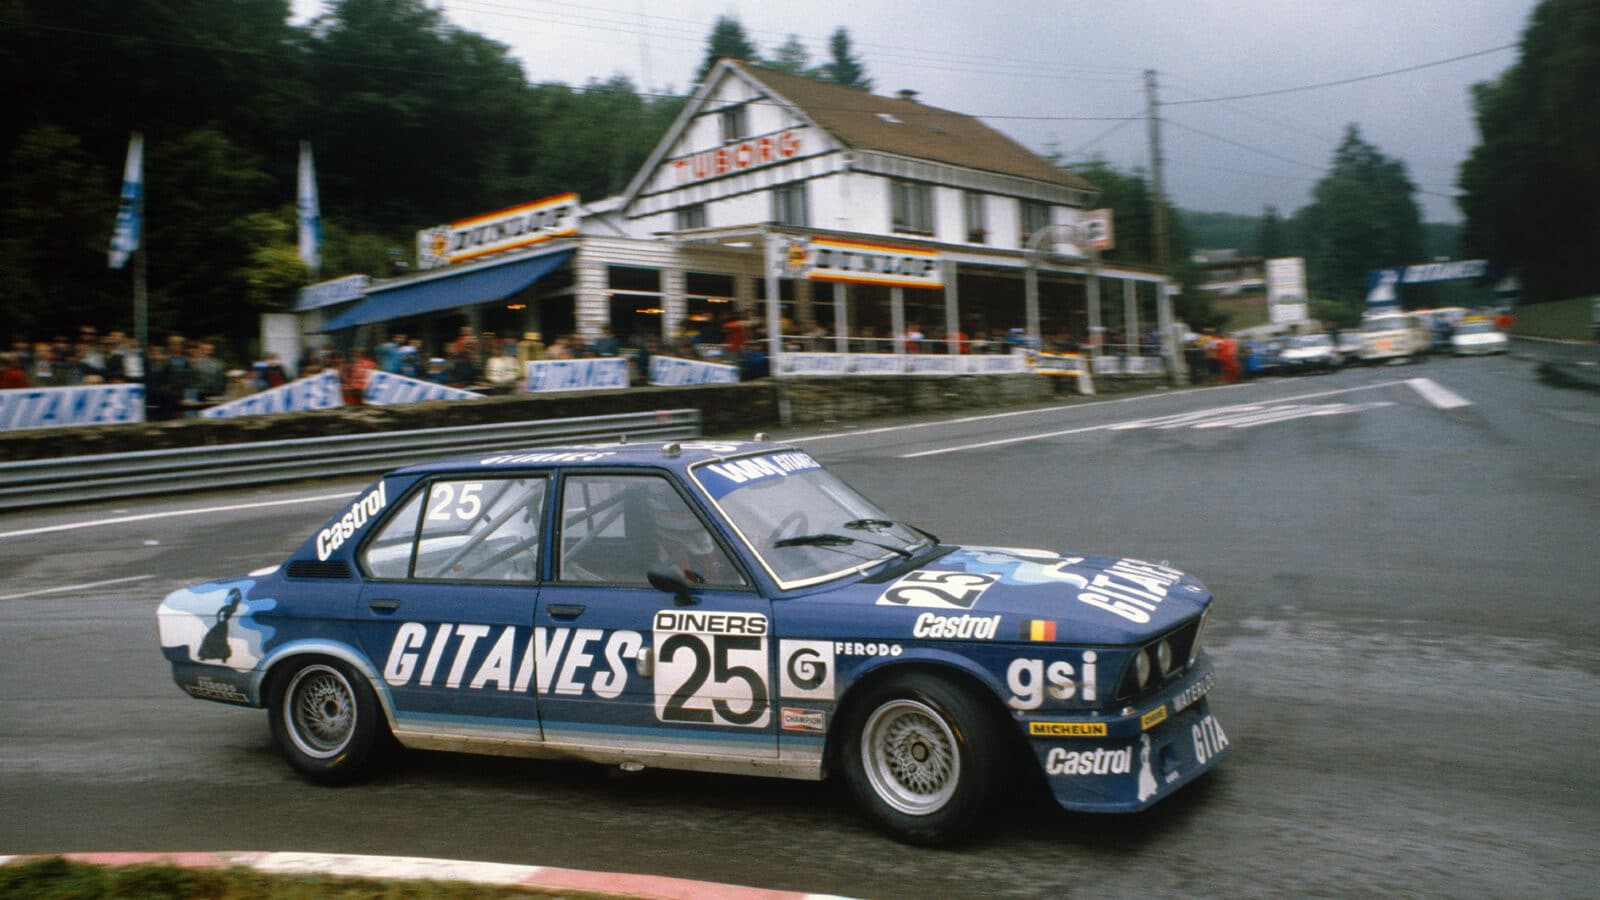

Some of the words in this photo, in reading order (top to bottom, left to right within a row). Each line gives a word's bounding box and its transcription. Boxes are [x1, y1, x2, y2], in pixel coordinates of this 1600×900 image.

[673, 130, 802, 181] TUBORG
[813, 248, 936, 278] DUNLOP
[428, 483, 483, 521] 25
[316, 480, 387, 562] Castrol
[885, 572, 995, 608] 25
[656, 613, 767, 634] DINERS
[912, 612, 1001, 639] Castrol
[383, 621, 643, 699] GITANES
[835, 641, 903, 656] FERODO
[658, 633, 768, 725] 25
[1006, 650, 1098, 710] gsi
[784, 712, 825, 727] CHAMPION
[1033, 724, 1103, 735] MICHELIN
[1192, 713, 1229, 764] GITA
[1046, 746, 1133, 775] Castrol
